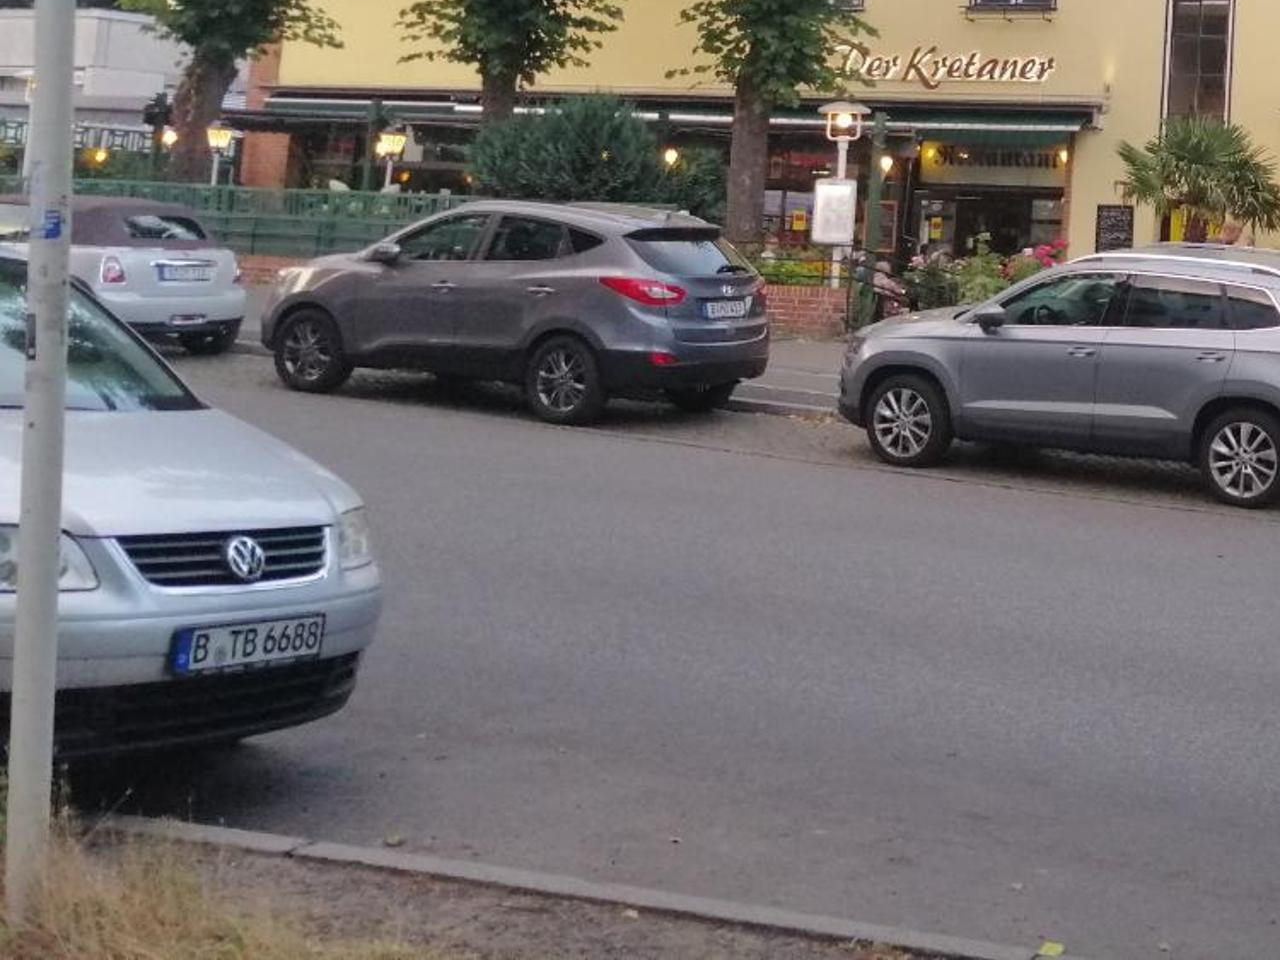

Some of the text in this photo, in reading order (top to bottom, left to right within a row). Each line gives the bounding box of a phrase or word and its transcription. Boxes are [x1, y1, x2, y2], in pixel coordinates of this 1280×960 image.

[832, 43, 1054, 90] Der Kretaner
[230, 628, 258, 659] TB
[263, 620, 320, 654] 6688
